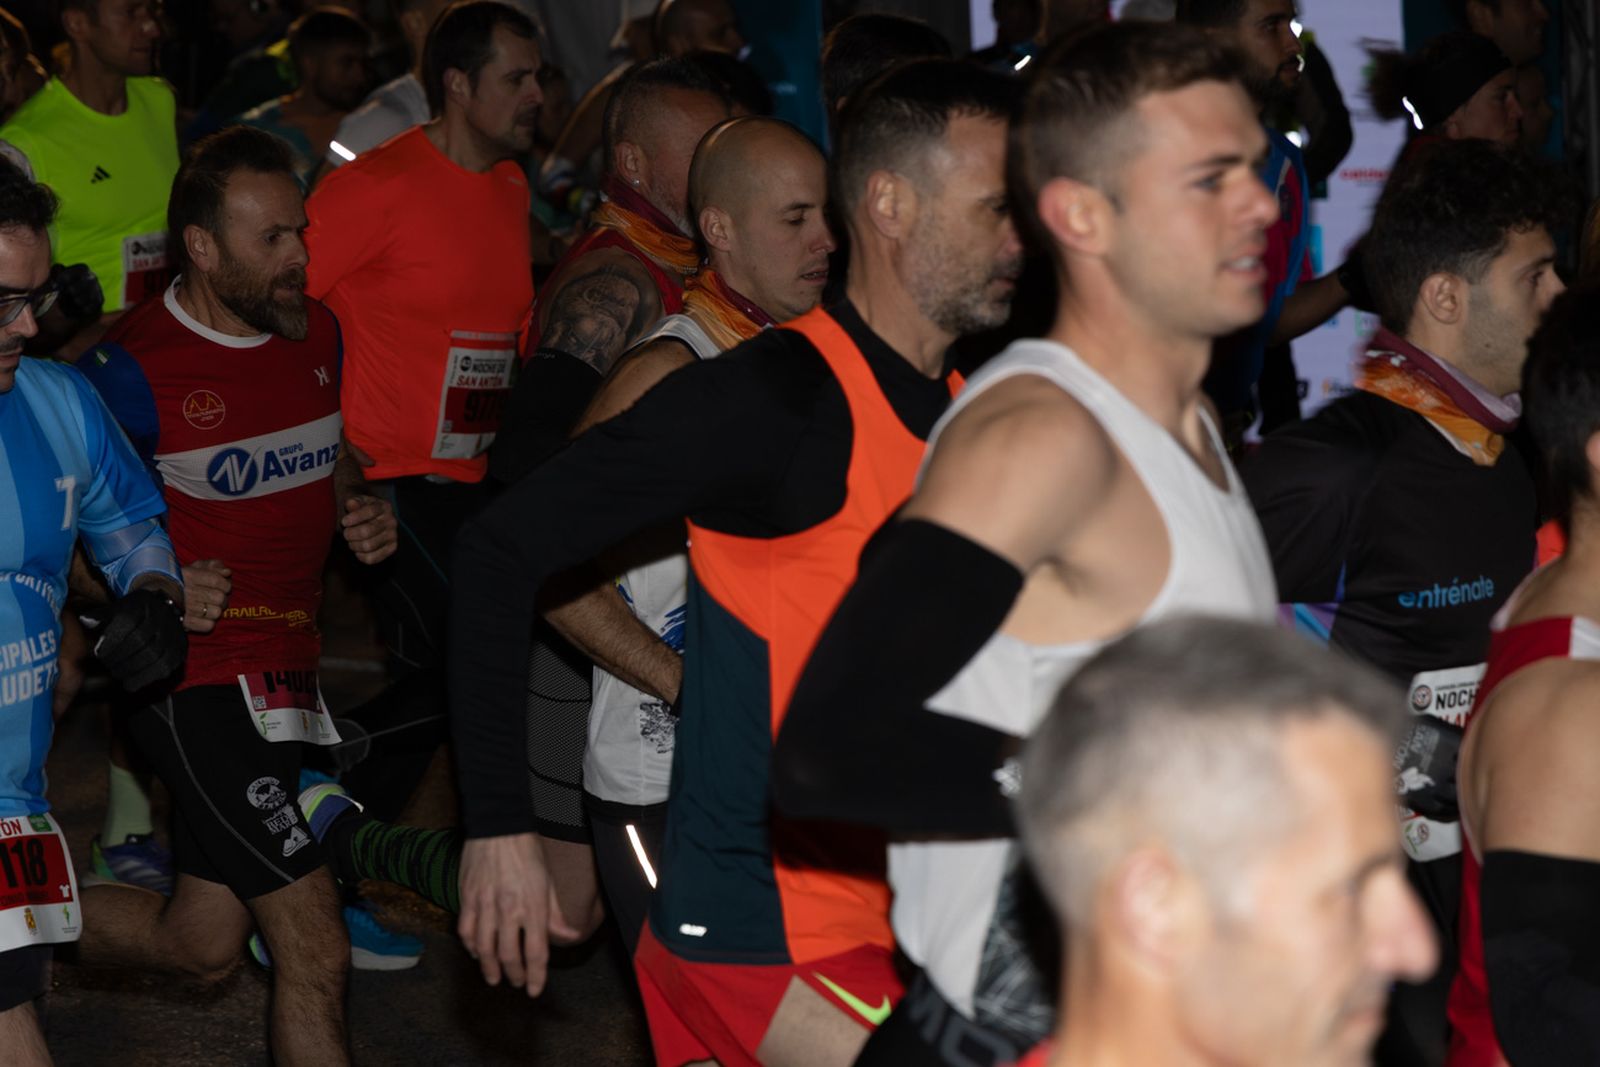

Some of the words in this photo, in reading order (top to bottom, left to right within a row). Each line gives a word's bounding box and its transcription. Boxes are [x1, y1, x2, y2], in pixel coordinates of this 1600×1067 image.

[279, 443, 304, 457] GRUPO
[54, 475, 77, 531] 7
[0, 629, 57, 672] IPALES
